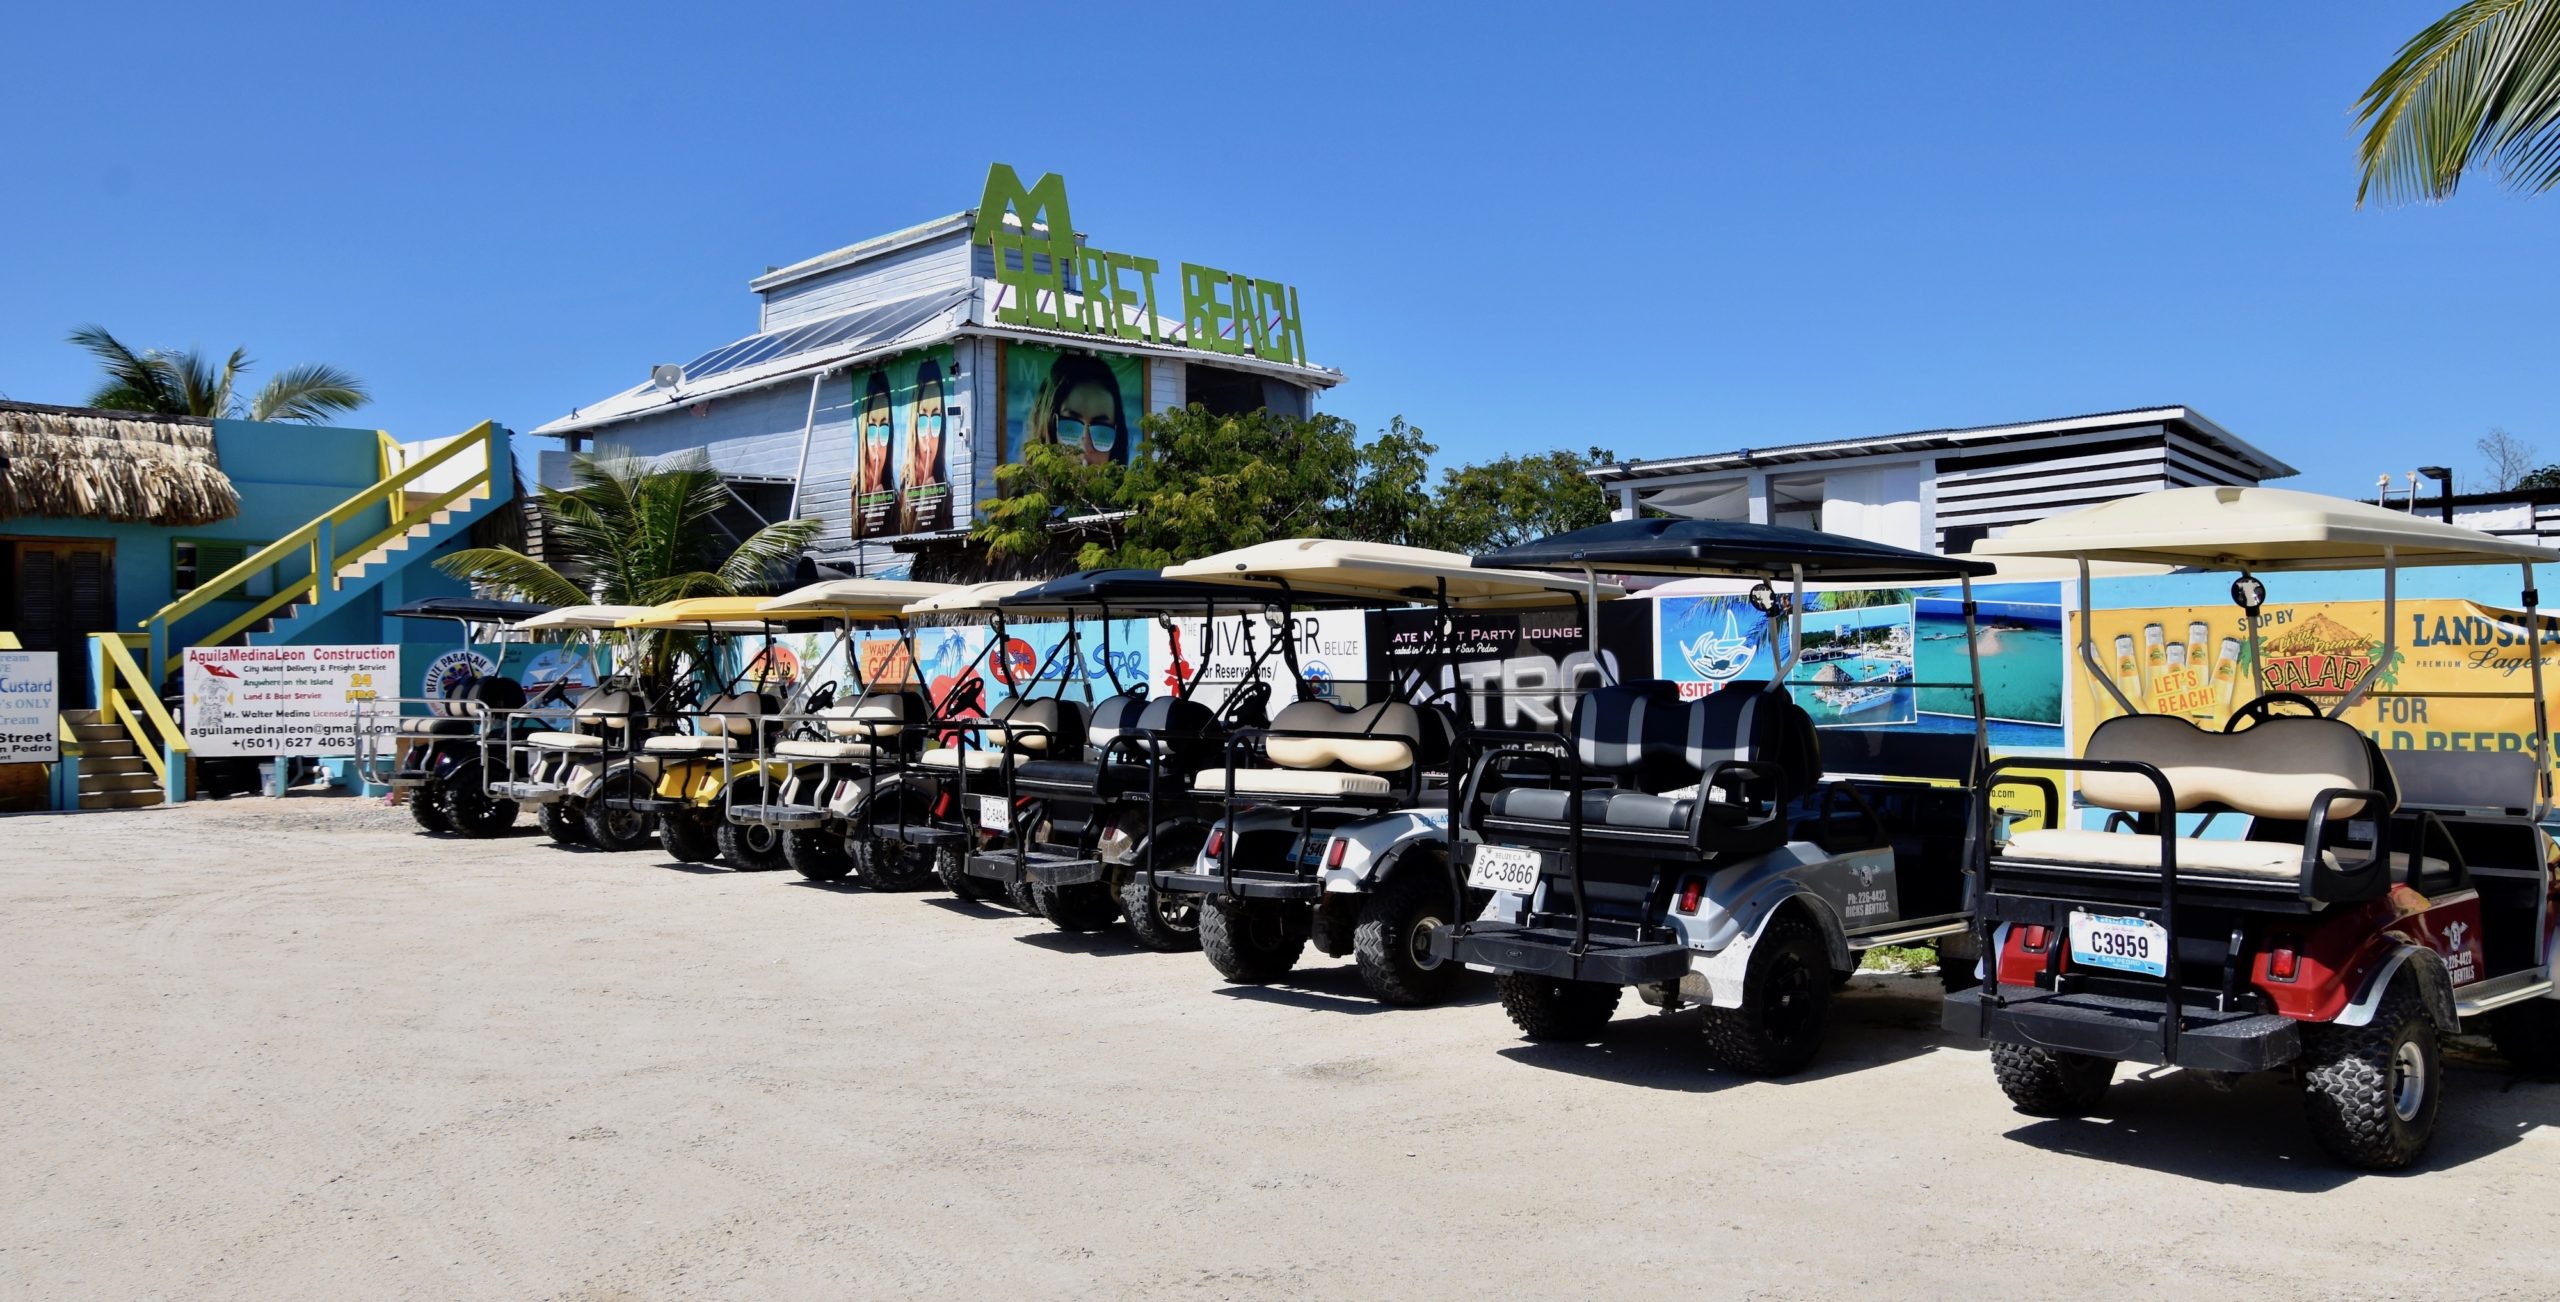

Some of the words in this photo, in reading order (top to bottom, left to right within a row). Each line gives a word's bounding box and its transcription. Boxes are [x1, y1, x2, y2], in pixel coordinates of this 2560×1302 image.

[972, 162, 1076, 246] M
[2238, 614, 2272, 632] SOP
[2277, 609, 2294, 625] BY
[1184, 624, 1197, 636] THE
[1201, 621, 1256, 656] DIVE
[1271, 617, 1321, 654] BAR
[1324, 641, 1358, 656] BELIZE
[1393, 633, 1418, 643] ATE
[1471, 629, 1516, 641] PARTY
[1522, 627, 1583, 640] LOUNGE
[870, 644, 889, 656] WANT
[1476, 642, 1499, 654] Pedro
[190, 649, 305, 664] AguilaMedinaLeon
[313, 648, 395, 660] Construction
[243, 666, 259, 674] City
[286, 665, 317, 674] Delivery
[329, 664, 355, 673] Freight
[868, 657, 895, 679] GOT
[2416, 660, 2461, 668] PREMIUM
[243, 680, 281, 688] Anywhere
[350, 673, 372, 687] 24
[426, 664, 443, 692] BELIZE
[2154, 670, 2198, 695] LET'S
[0, 678, 52, 693] Custard
[294, 692, 322, 700] Service
[2158, 687, 2216, 714] BEACH!
[15, 698, 50, 709] ONLY
[2378, 697, 2428, 723] FOR
[224, 711, 239, 719] Mr.
[241, 710, 273, 718] Walter
[276, 709, 311, 718] Medina
[313, 709, 348, 717] Licensed
[190, 722, 395, 738] aguilamedinaleon@gmai.com
[0, 732, 52, 743] Street
[232, 738, 280, 750] +(501)
[285, 738, 312, 748] 627
[318, 737, 355, 748] 4063
[13, 744, 52, 753] Pedro
[1484, 860, 1534, 885] C-3866
[2092, 931, 2148, 958] C3959
[2102, 956, 2117, 964] SAN
[2118, 957, 2141, 966] PEDRO
